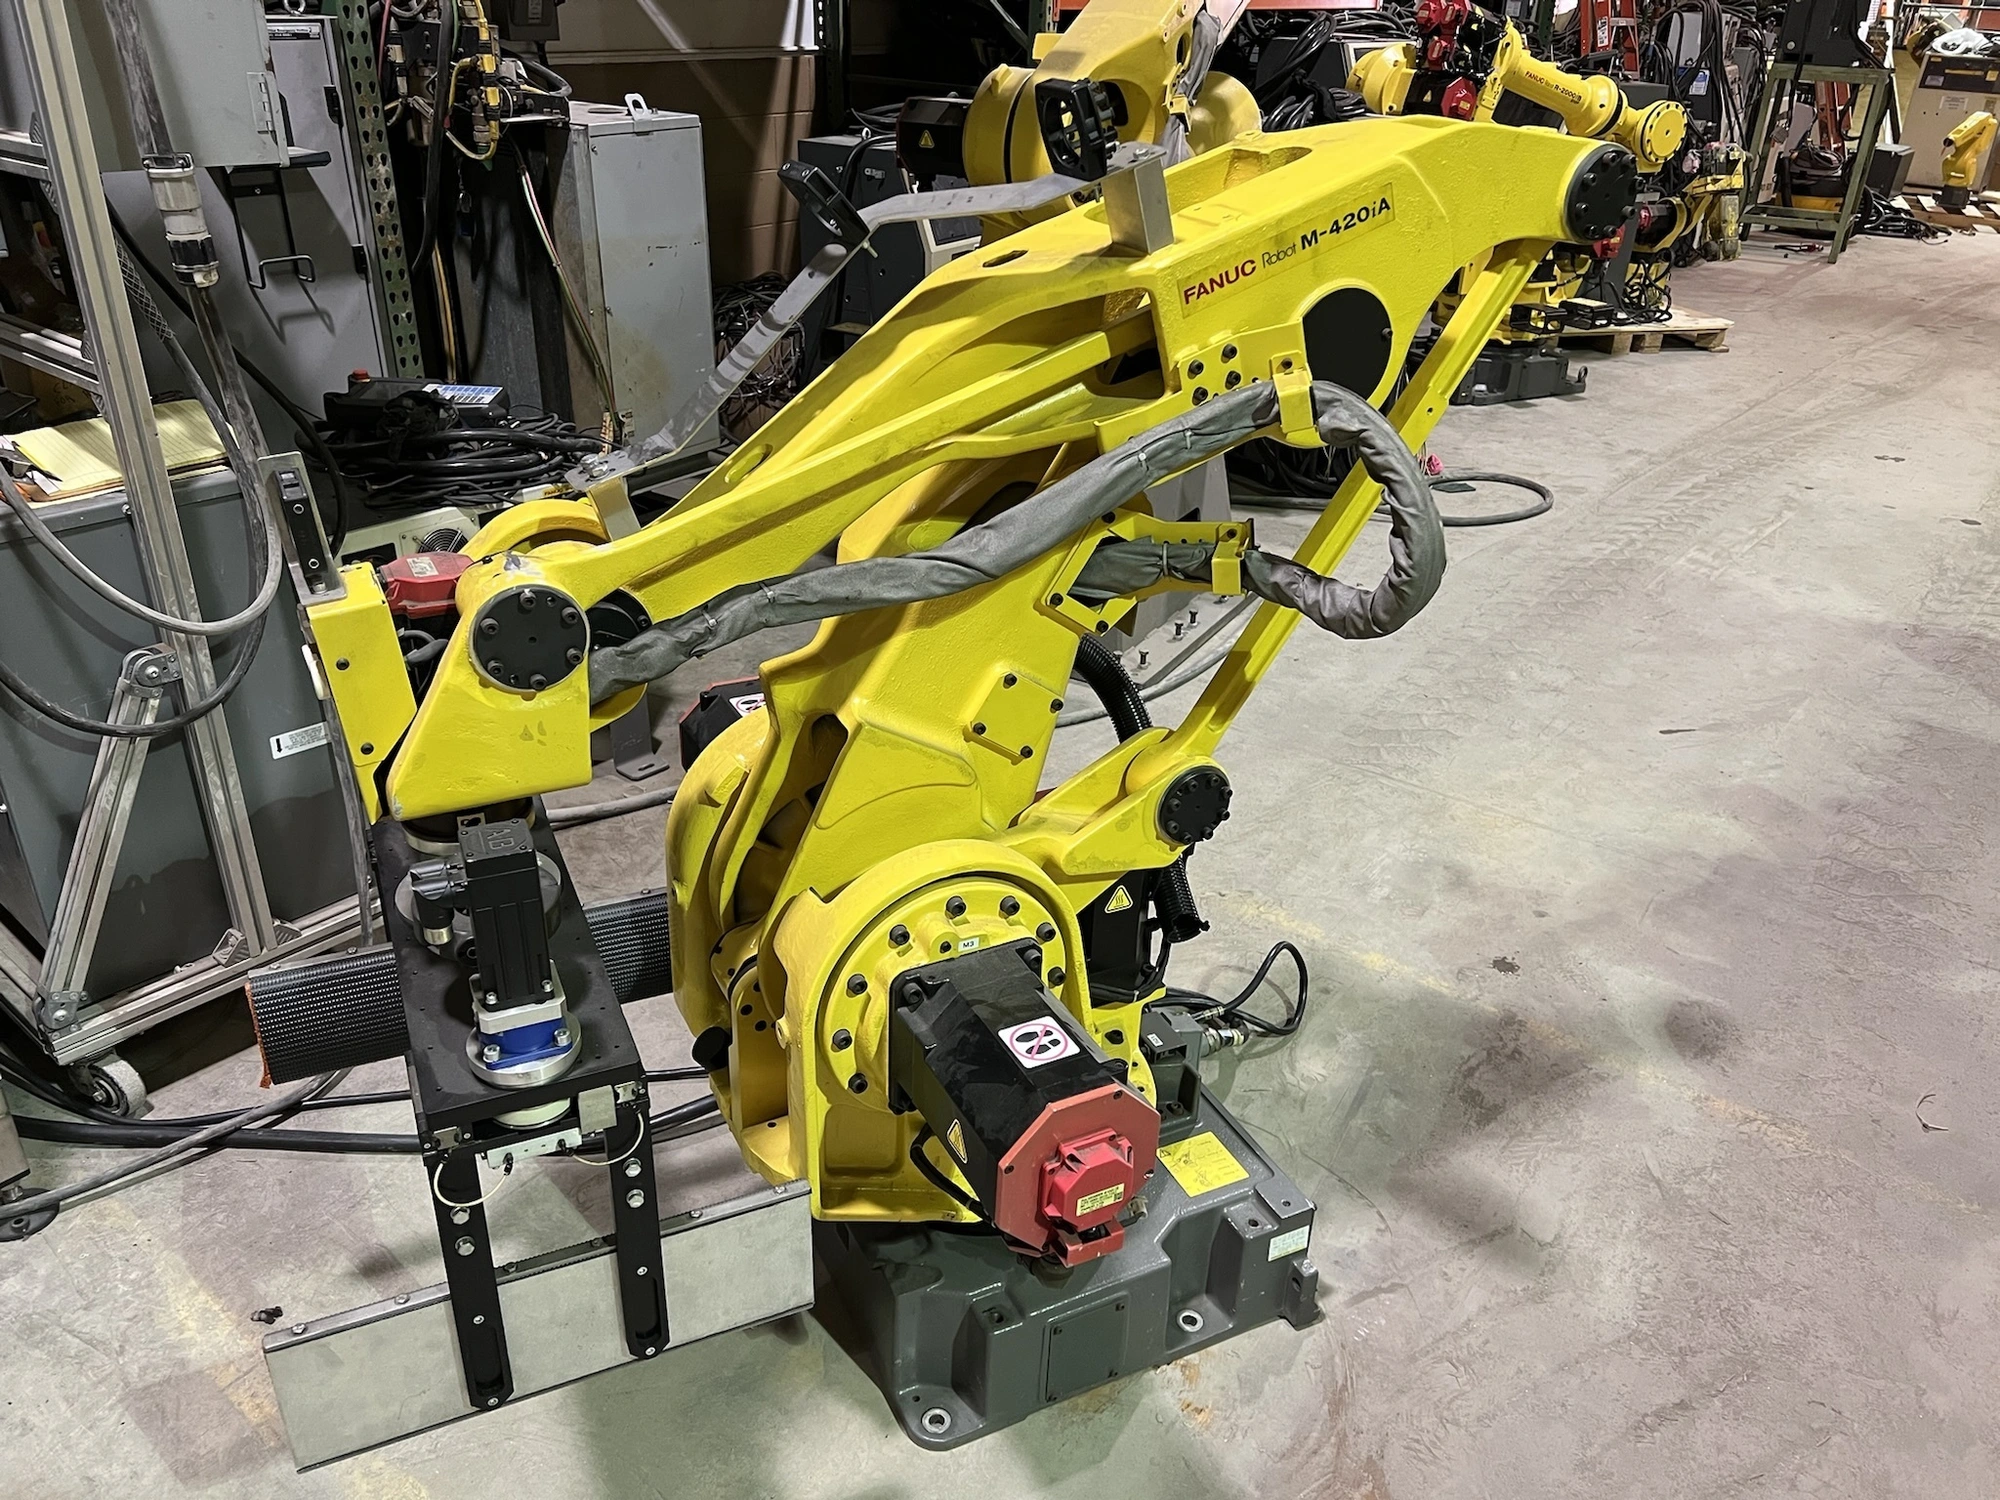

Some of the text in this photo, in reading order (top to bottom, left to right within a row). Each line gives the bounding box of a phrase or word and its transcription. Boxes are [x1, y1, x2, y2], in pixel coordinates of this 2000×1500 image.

[1525, 71, 1545, 84] FANUC
[1183, 197, 1391, 305] FANUC Robot M-420iA
[963, 940, 975, 949] M3
